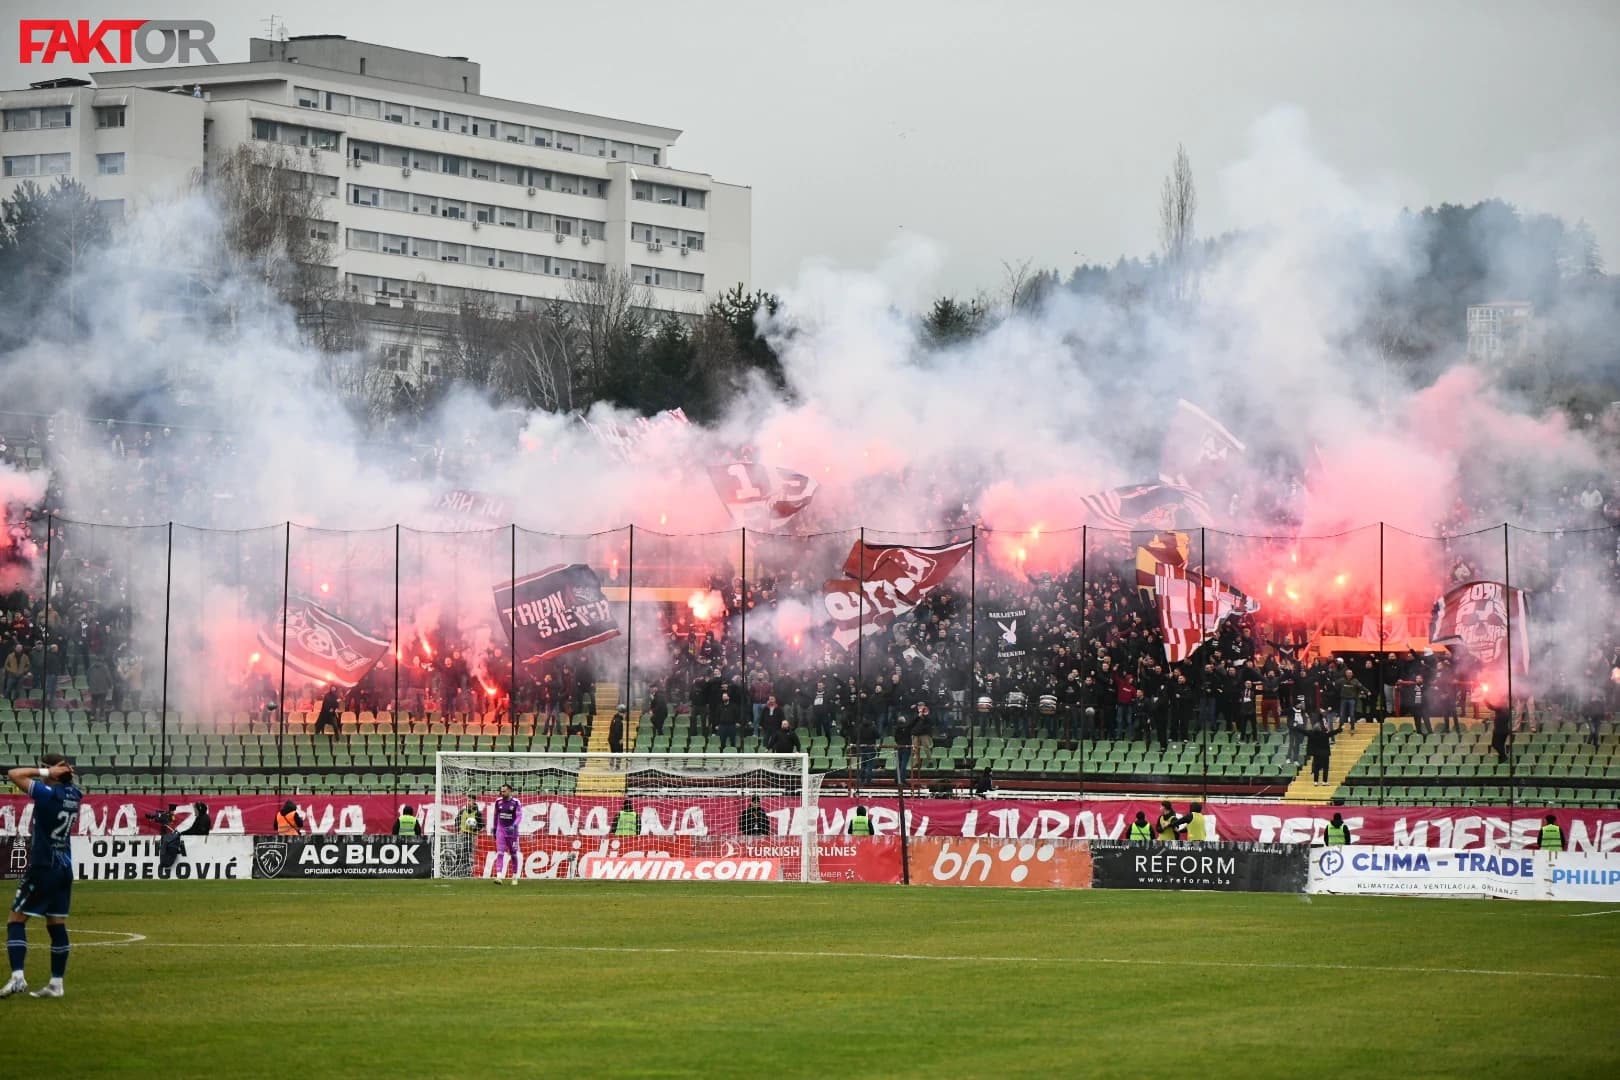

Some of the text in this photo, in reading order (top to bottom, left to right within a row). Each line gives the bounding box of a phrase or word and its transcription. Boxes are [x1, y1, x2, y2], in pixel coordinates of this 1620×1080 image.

[296, 804, 366, 836] VA
[640, 806, 708, 837] NA
[299, 845, 420, 865] AC BLOK
[747, 847, 801, 857] TURKISH
[592, 860, 773, 880] wwin.com
[933, 843, 992, 882] bh
[1135, 855, 1235, 875] REFORM
[1352, 853, 1430, 872] CLIMA
[1454, 853, 1534, 877] TRADE
[1138, 876, 1230, 885] www.reform.ba
